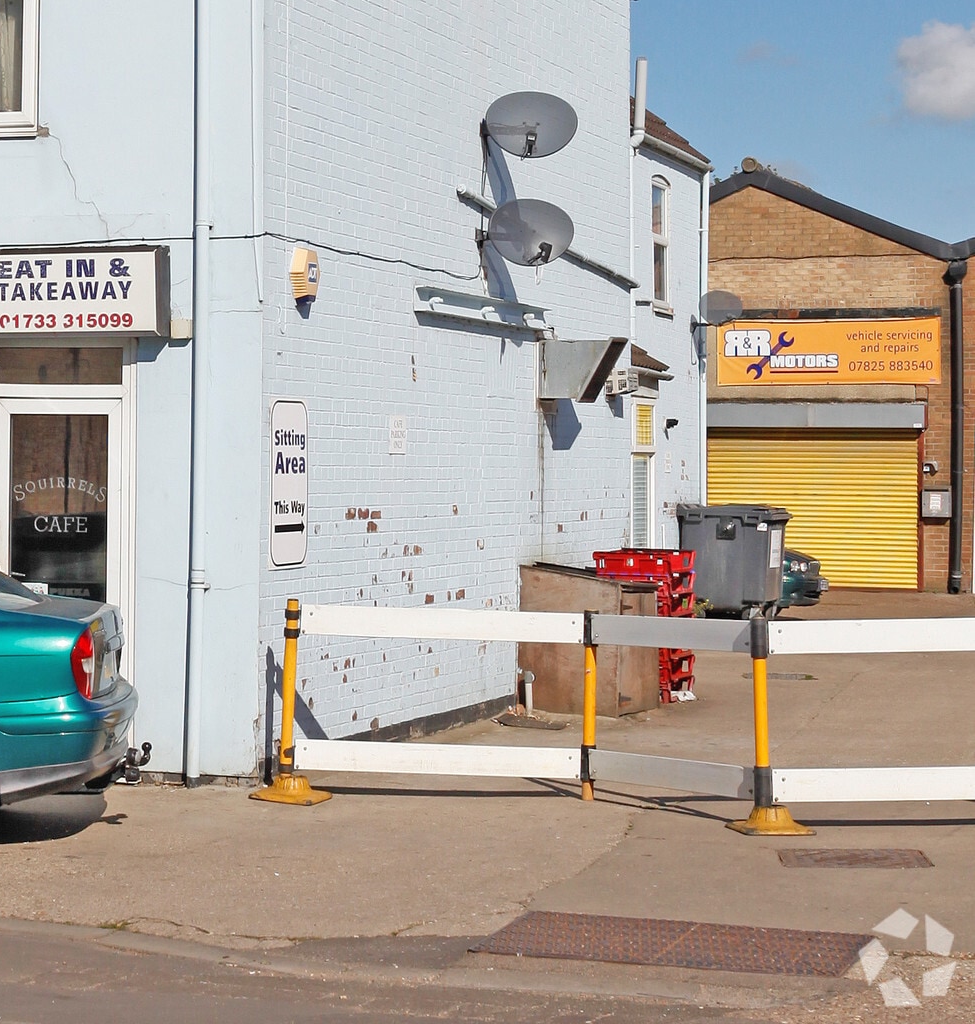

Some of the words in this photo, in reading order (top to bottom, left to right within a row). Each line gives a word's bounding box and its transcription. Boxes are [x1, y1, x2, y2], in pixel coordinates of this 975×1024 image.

[66, 259, 95, 277] IN
[109, 258, 131, 277] &
[0, 314, 57, 329] 01733
[63, 313, 133, 328] 315099
[846, 330, 883, 341] vehicle
[886, 330, 933, 342] servicing
[860, 343, 880, 353] and
[884, 342, 919, 355] repairs
[769, 354, 839, 369] MOTORS
[848, 361, 885, 371] 07825
[889, 360, 933, 371] 883540
[274, 429, 306, 450] Sitting
[274, 452, 306, 474] Area
[13, 476, 107, 503] SQUIRRELS
[274, 501, 290, 515] This
[290, 501, 306, 517] Way
[34, 515, 88, 533] CAFE
